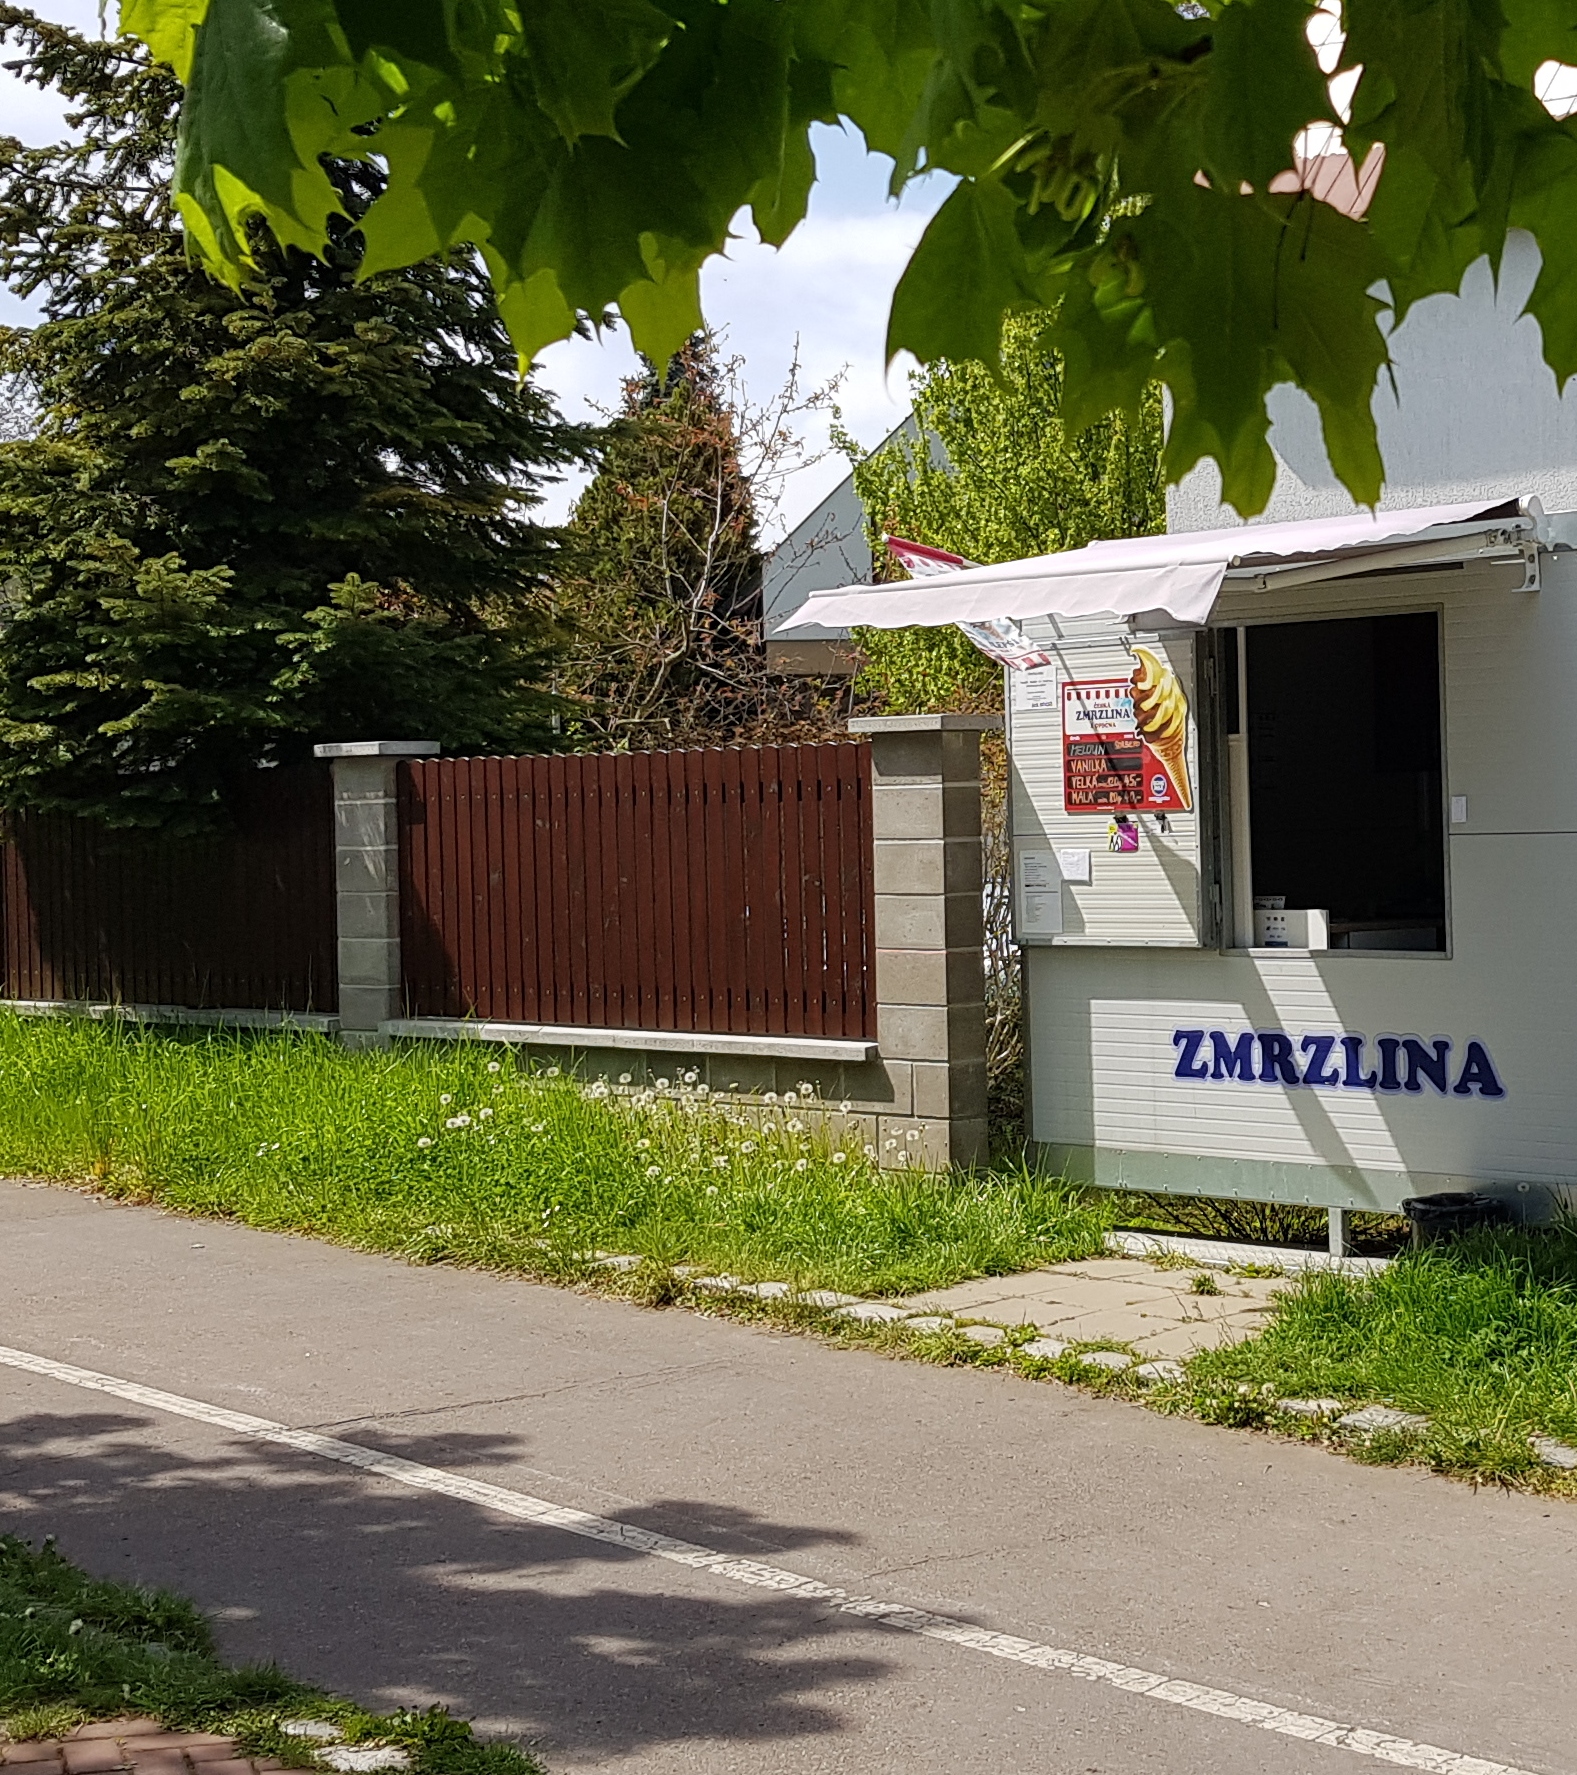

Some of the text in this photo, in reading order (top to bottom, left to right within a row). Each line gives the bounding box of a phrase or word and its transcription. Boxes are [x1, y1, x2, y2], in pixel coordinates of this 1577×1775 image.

[1075, 708, 1131, 721] ZMRZLINA
[1070, 758, 1108, 774] VANILKA
[1071, 773, 1098, 789] VELKÁ
[1071, 790, 1096, 804] MALÁ
[1172, 1029, 1506, 1097] ZMRZLINA
